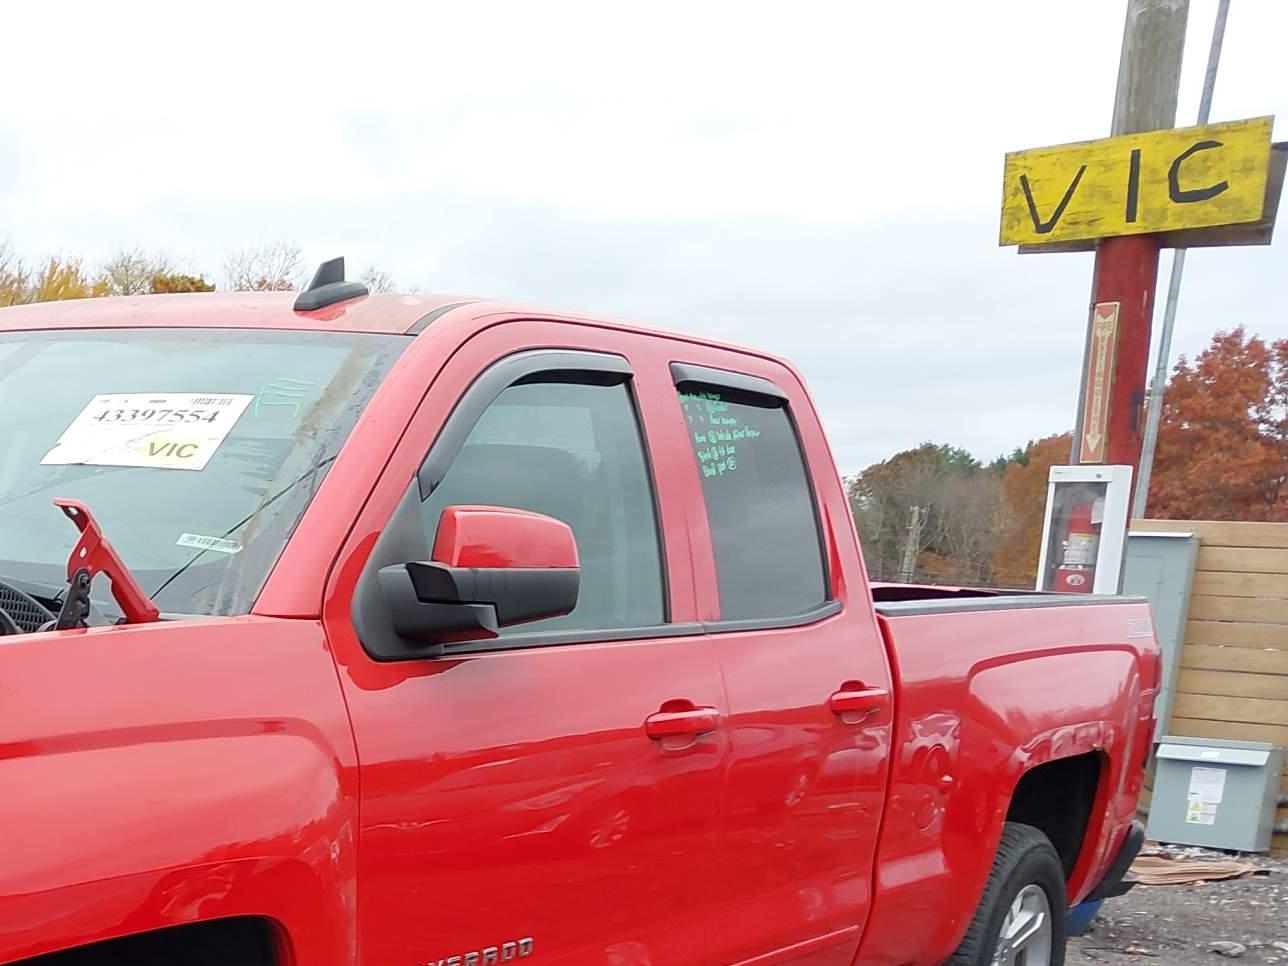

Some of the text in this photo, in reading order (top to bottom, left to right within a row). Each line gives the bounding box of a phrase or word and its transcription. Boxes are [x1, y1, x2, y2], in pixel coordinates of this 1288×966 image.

[1018, 139, 1229, 234] VIC
[93, 408, 220, 423] 43397554
[148, 441, 199, 459] VIC
